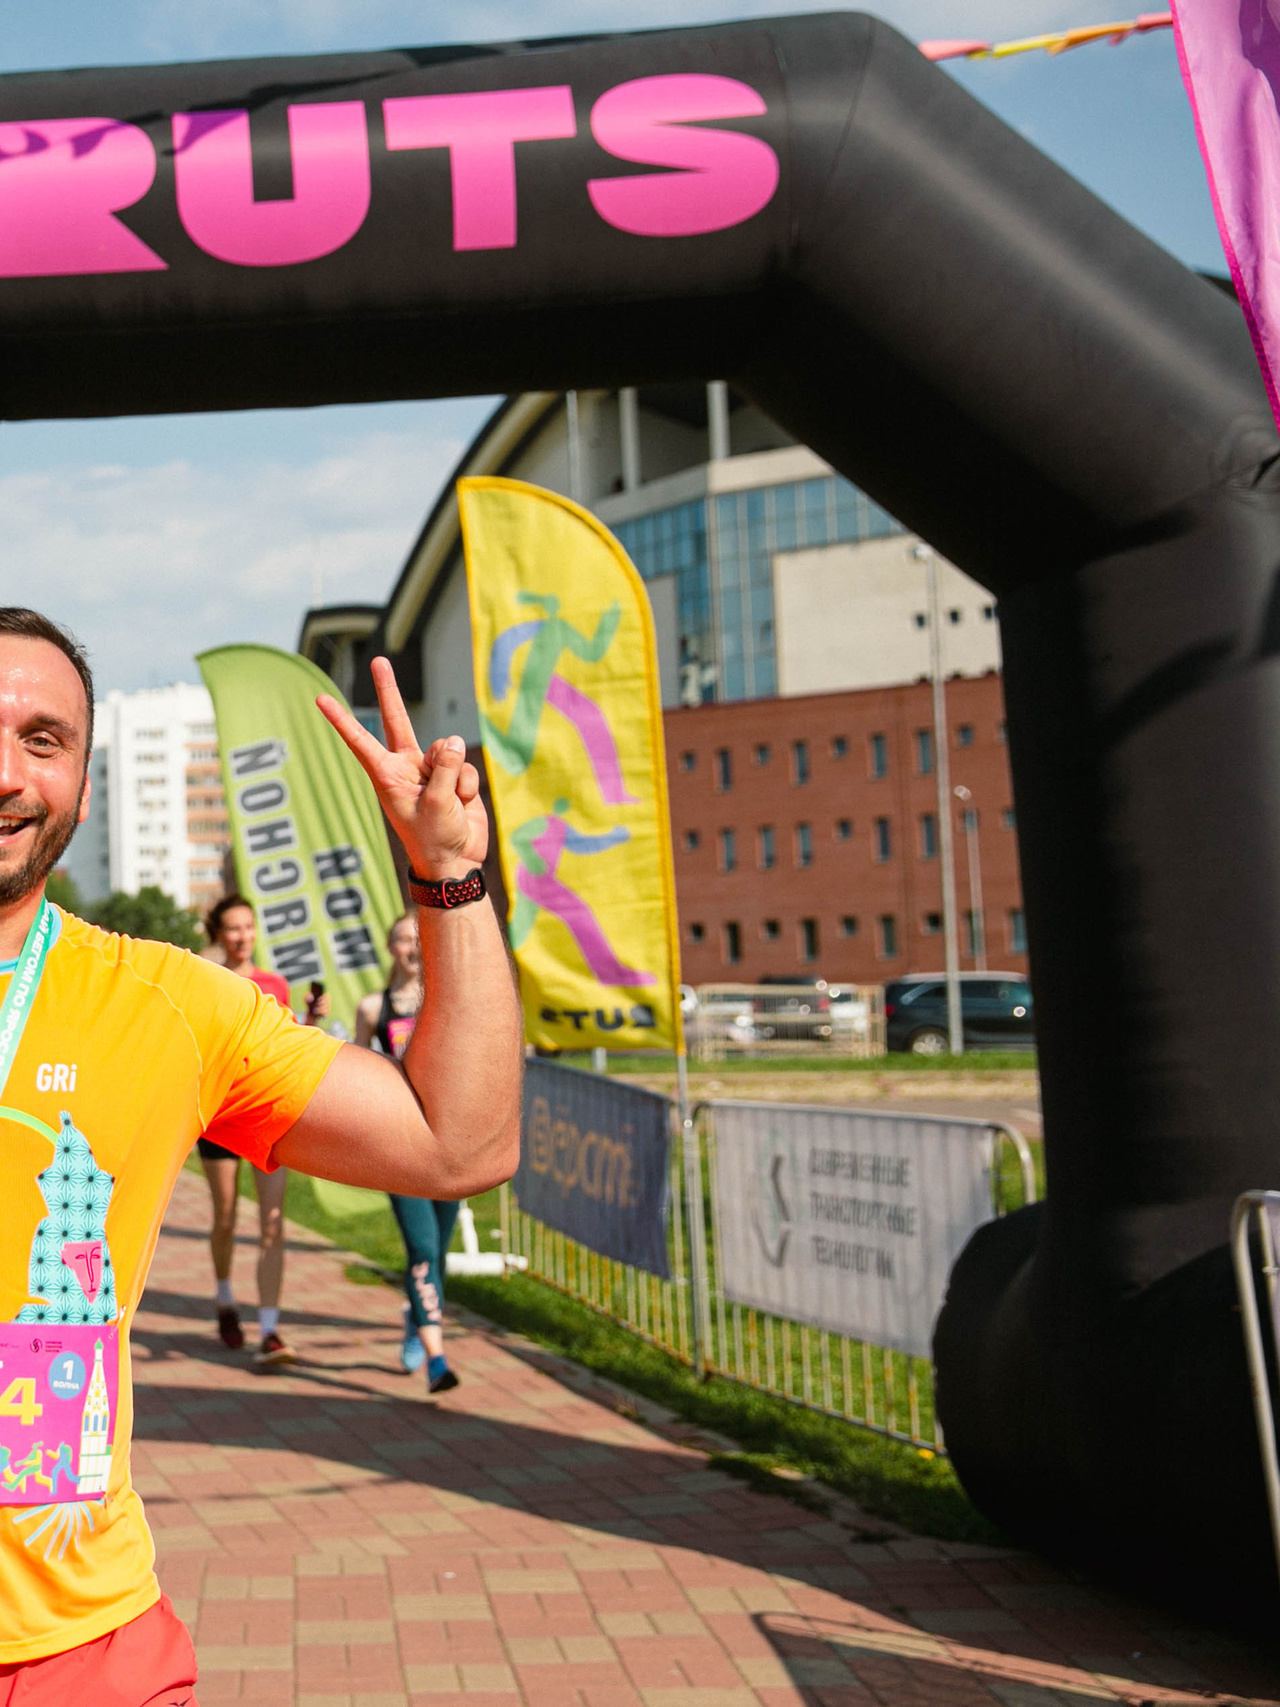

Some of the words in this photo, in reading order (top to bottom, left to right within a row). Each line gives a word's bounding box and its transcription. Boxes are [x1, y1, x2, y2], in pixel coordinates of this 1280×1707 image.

[22, 933, 46, 983] БЕГОМ
[13, 983, 30, 1008] ПО
[36, 1063, 78, 1092] GRi
[62, 1360, 74, 1380] 1
